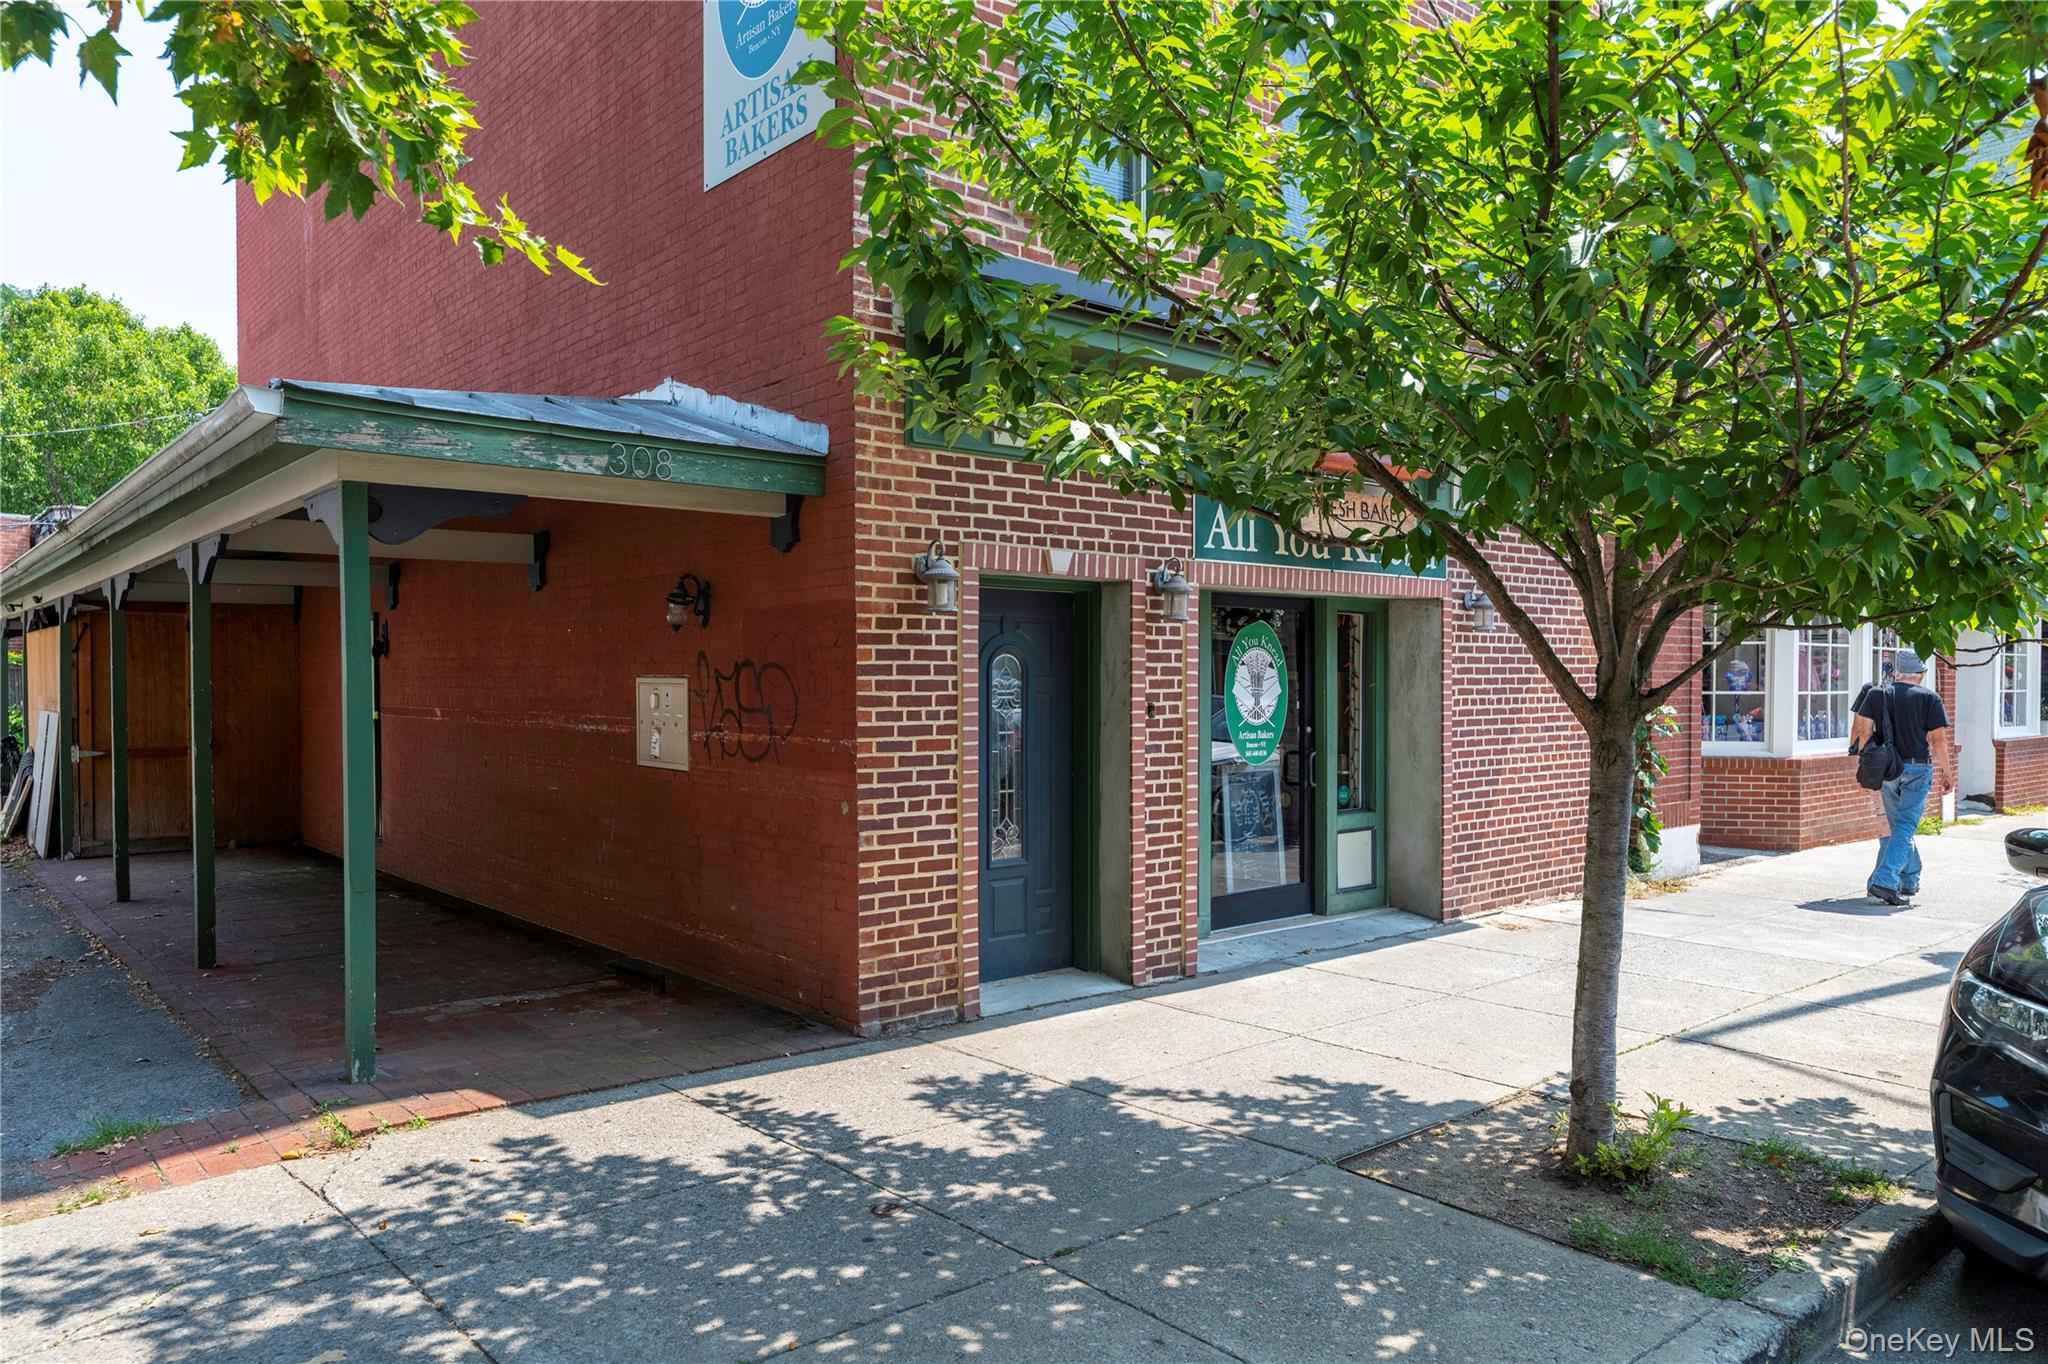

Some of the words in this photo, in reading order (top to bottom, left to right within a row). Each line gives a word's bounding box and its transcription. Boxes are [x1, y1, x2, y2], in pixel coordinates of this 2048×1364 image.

[735, 20, 766, 49] Artisan
[768, 0, 797, 26] Bakers
[720, 53, 814, 139] ARTISA
[725, 94, 808, 168] BAKERS
[609, 443, 673, 480] 308
[1203, 503, 1258, 552] All
[1232, 646, 1243, 666] All
[1241, 636, 1259, 651] You
[1260, 635, 1284, 667] Knead
